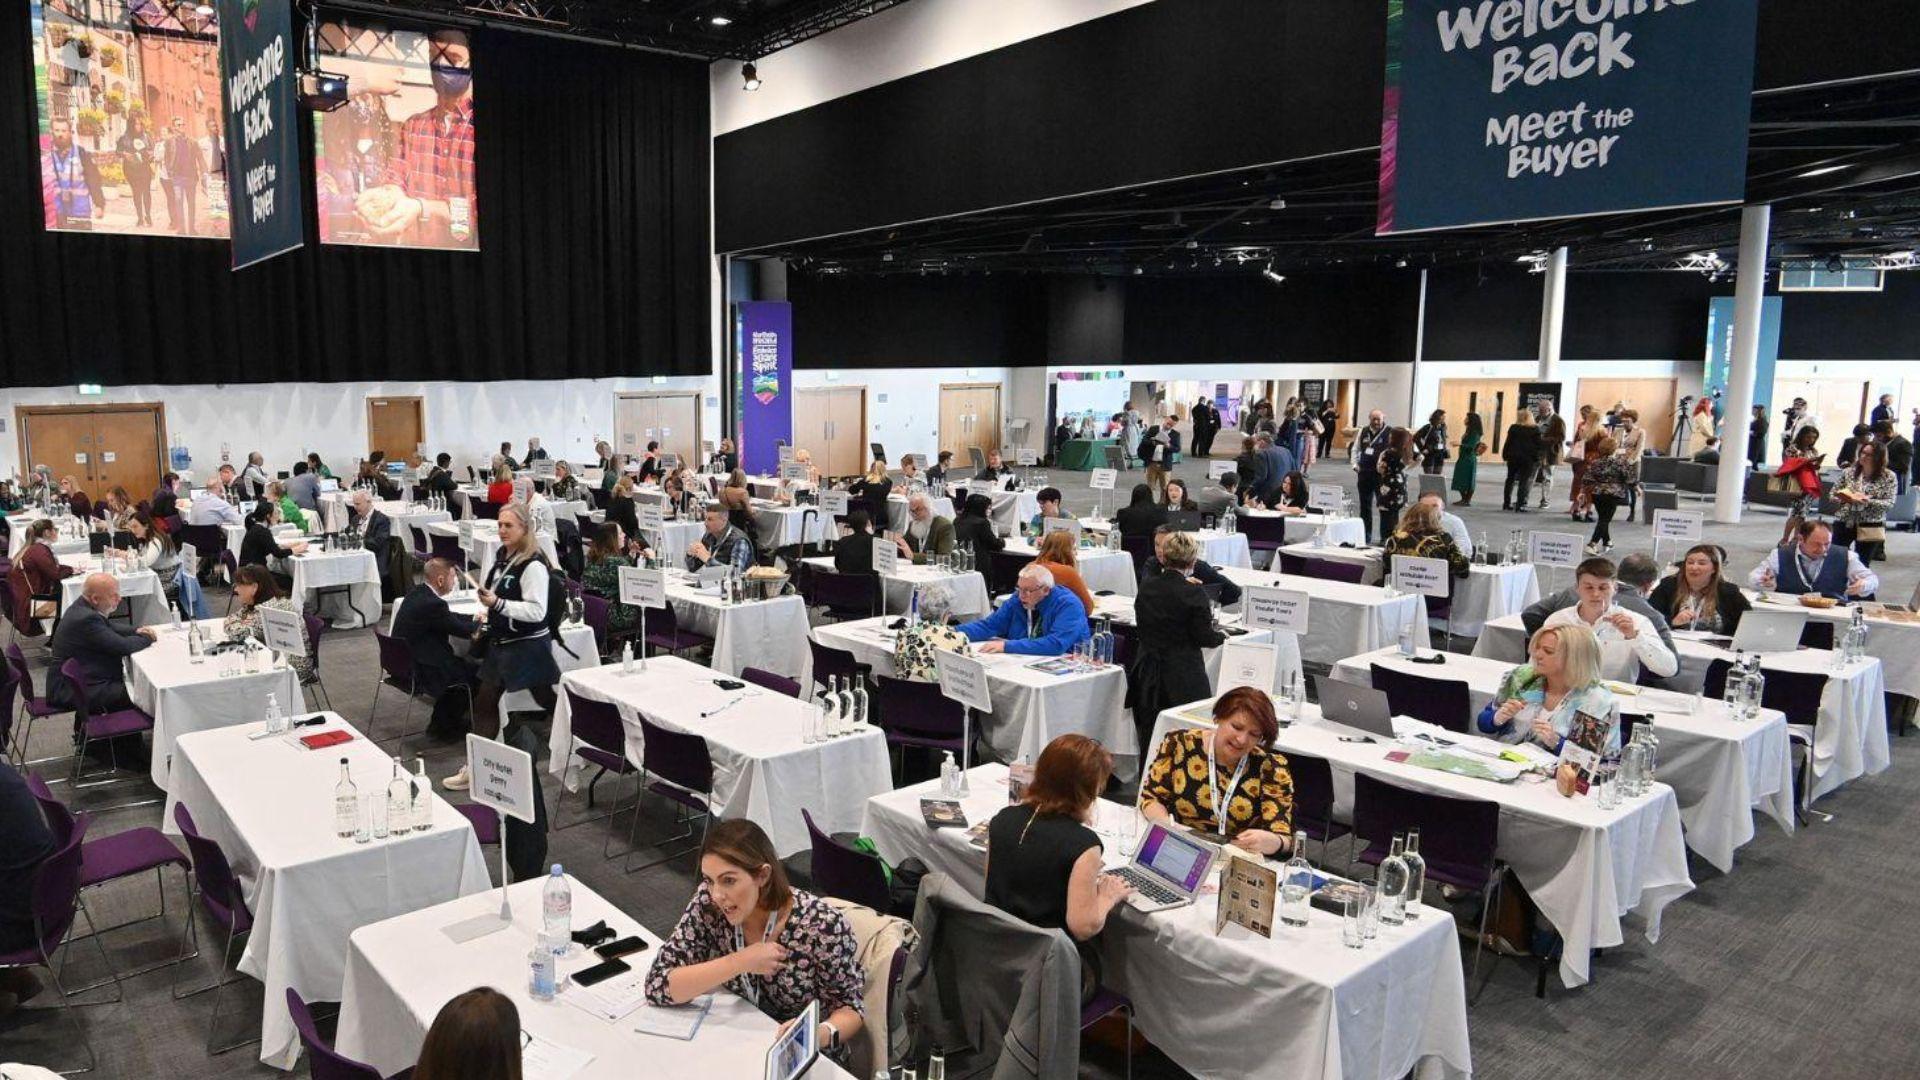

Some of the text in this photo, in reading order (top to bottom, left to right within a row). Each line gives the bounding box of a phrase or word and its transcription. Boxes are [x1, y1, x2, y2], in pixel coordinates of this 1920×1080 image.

[1436, 0, 1698, 52] Welco
[229, 34, 284, 114] Welcome
[1490, 22, 1635, 94] Back
[243, 91, 273, 151] Back
[1486, 101, 1634, 147] Meet the
[245, 159, 267, 197] Meet
[1507, 134, 1621, 179] Buyer
[252, 187, 275, 225] Buyer
